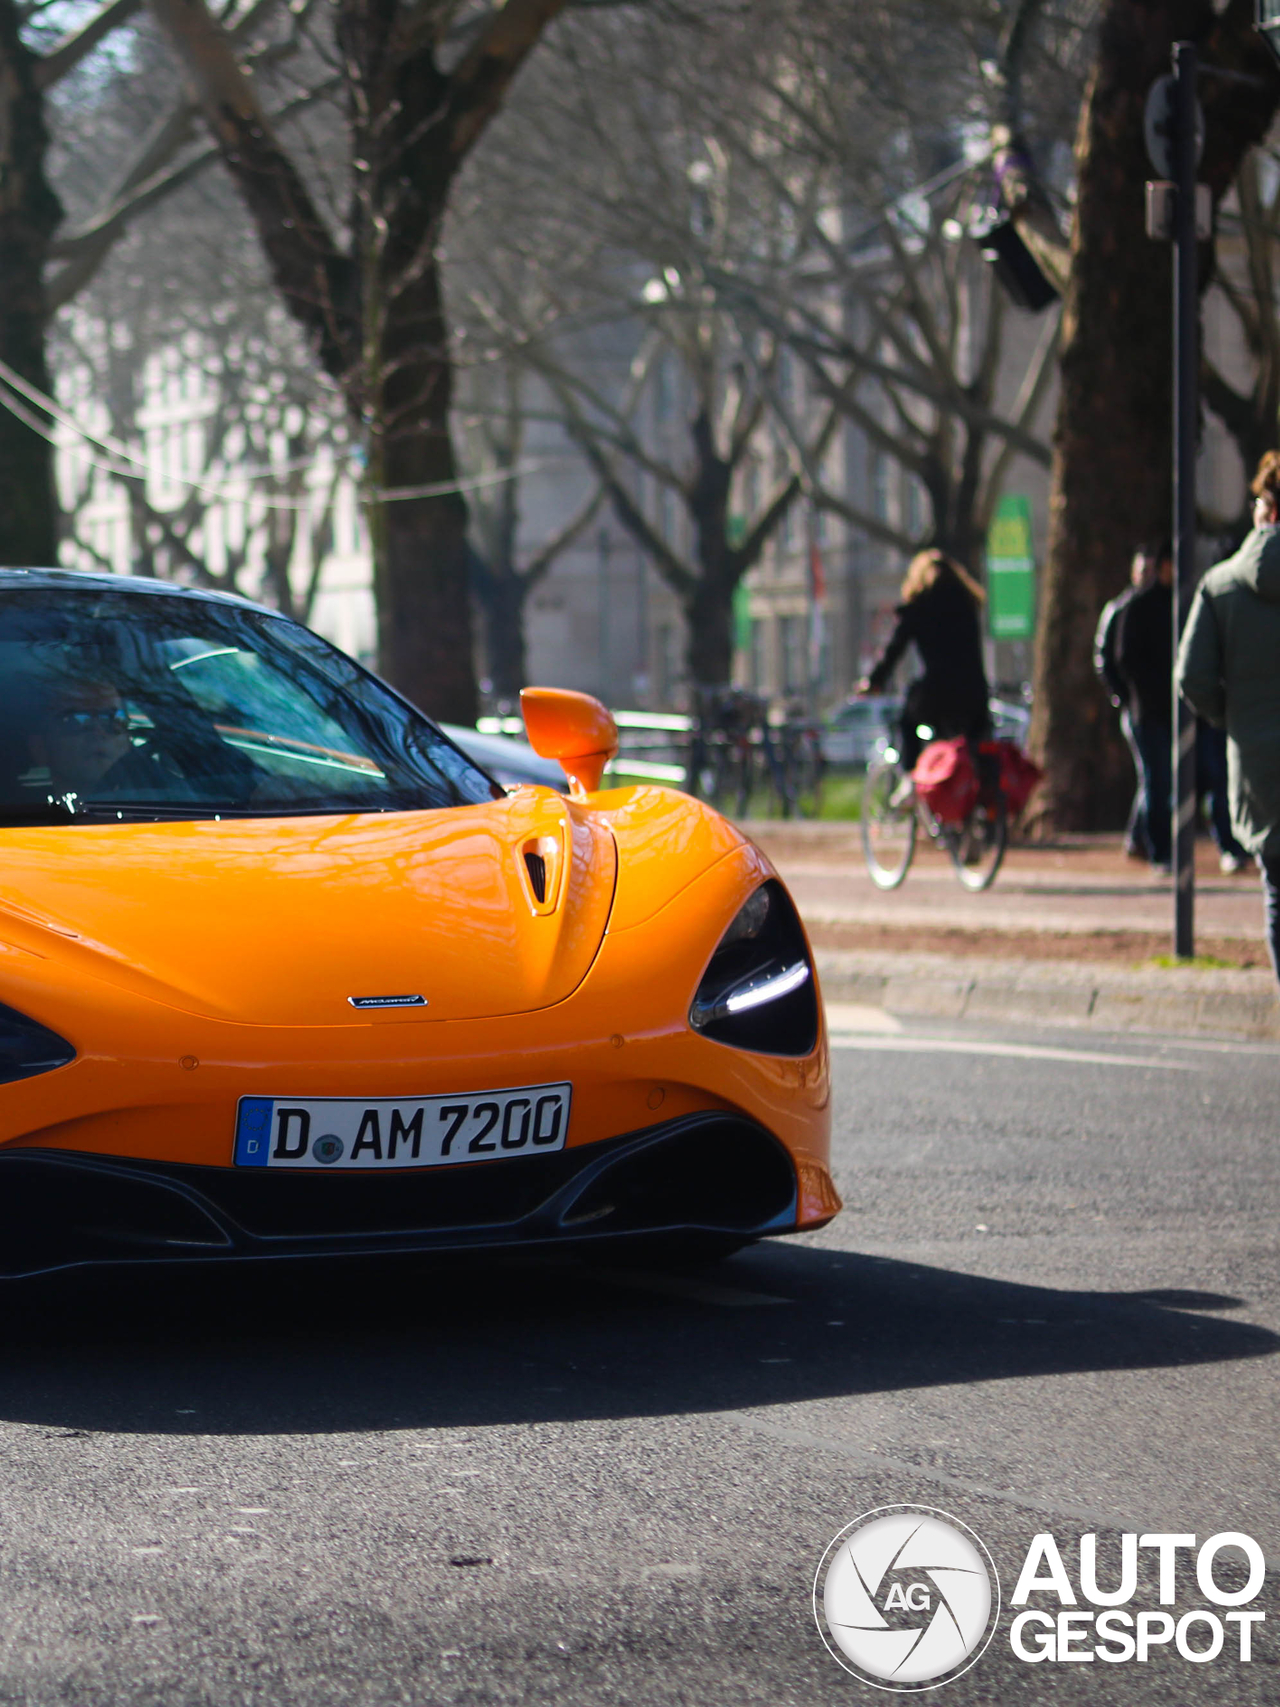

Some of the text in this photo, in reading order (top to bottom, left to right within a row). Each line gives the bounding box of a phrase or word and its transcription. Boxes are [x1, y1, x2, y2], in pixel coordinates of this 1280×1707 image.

[246, 1139, 259, 1155] D
[272, 1094, 563, 1160] D AM 7200
